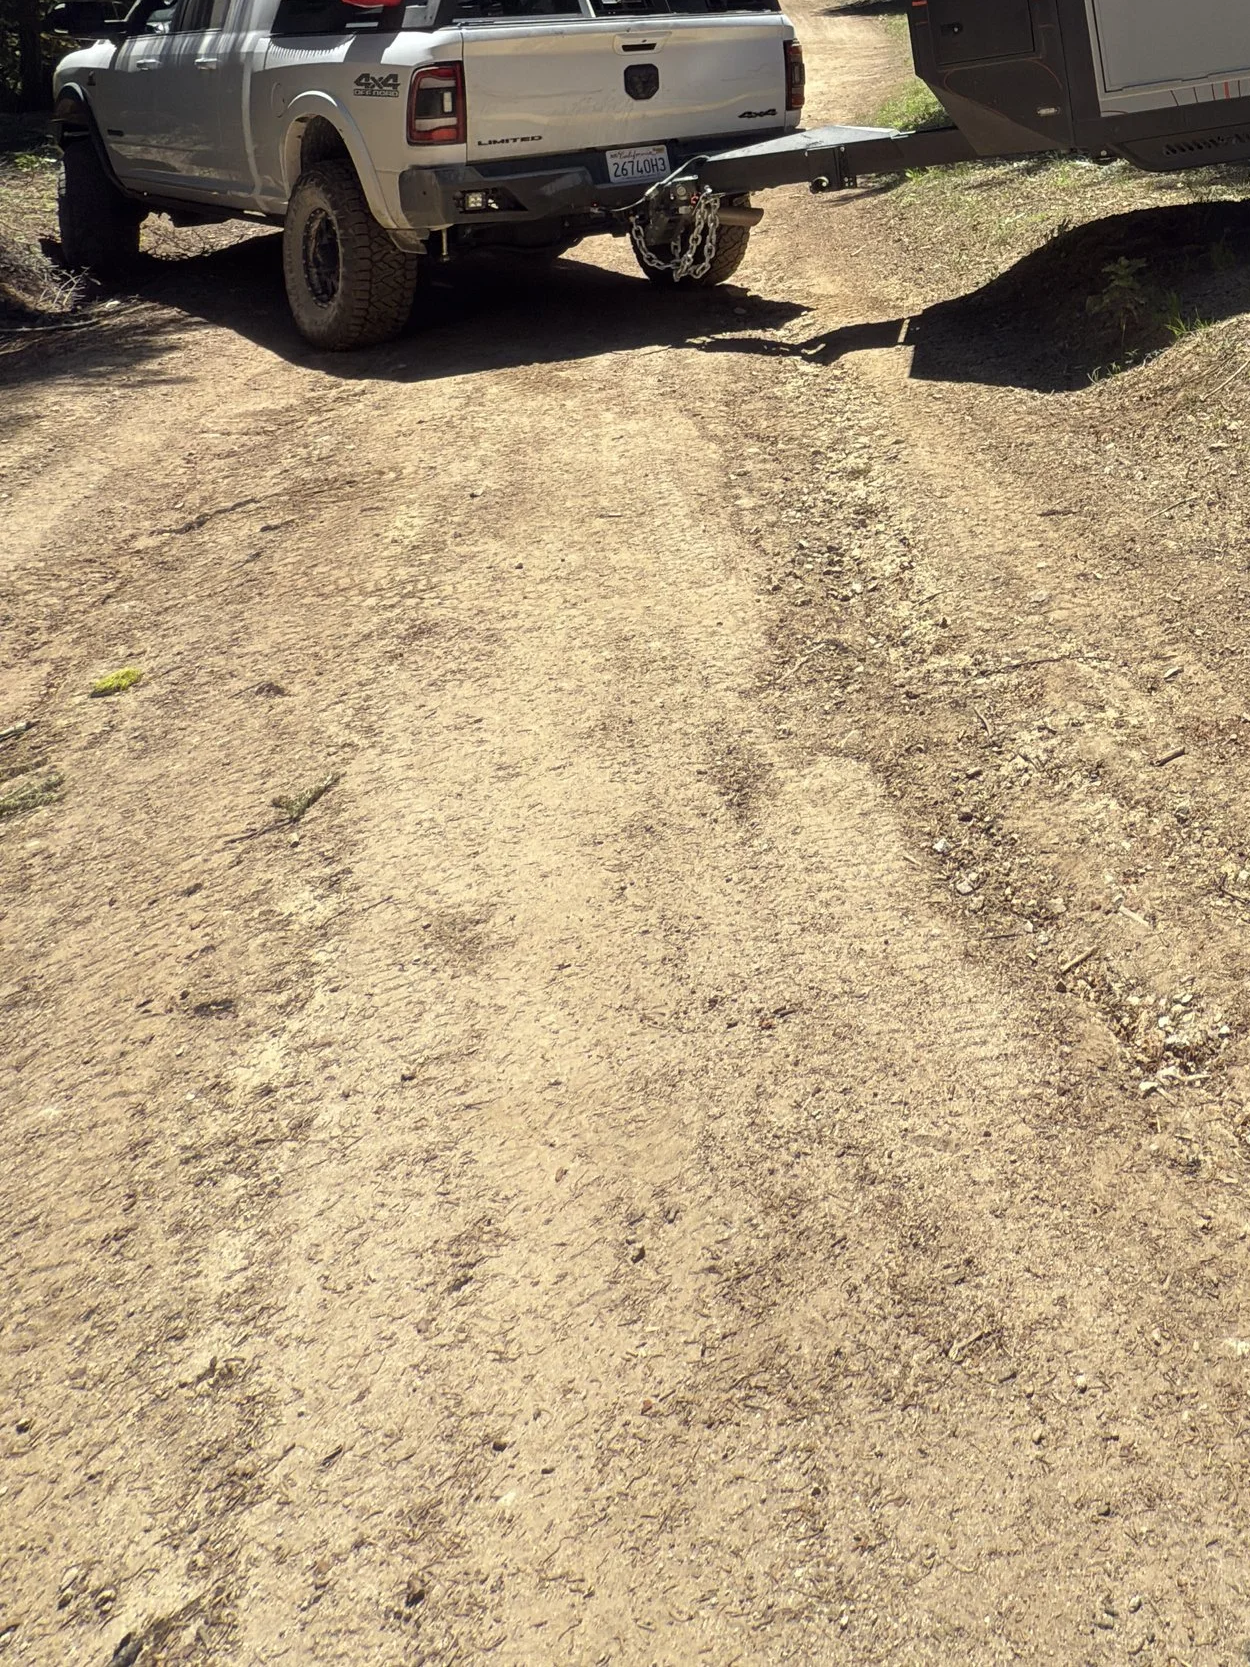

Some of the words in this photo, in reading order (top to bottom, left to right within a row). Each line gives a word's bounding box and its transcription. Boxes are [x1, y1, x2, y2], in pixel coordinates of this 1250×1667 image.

[477, 135, 543, 146] LIMITED
[617, 149, 654, 159] California
[612, 157, 666, 178] 26740H3
